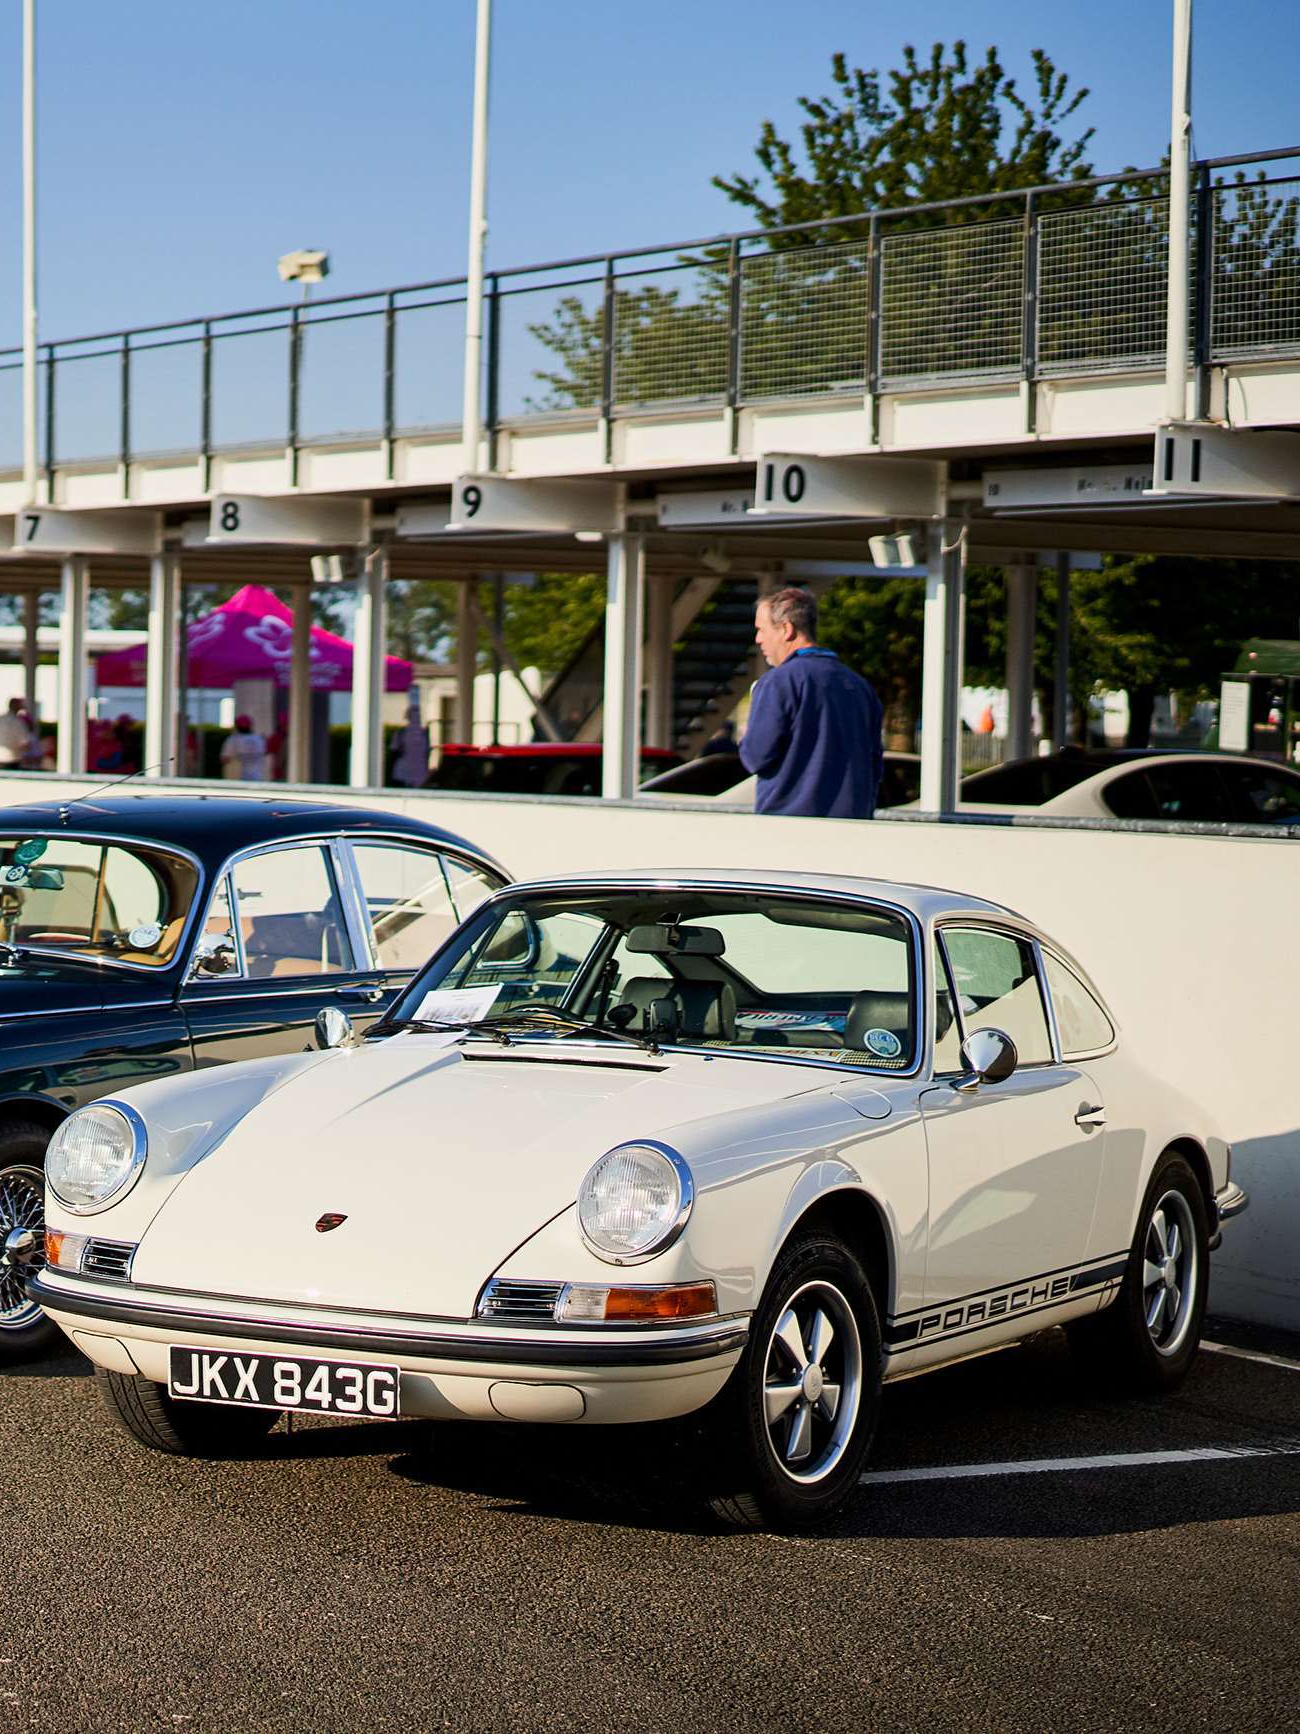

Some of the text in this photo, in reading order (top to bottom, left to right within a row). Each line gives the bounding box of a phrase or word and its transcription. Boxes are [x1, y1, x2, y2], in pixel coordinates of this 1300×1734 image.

[1164, 437, 1202, 482] 11
[463, 485, 482, 518] 9
[765, 464, 806, 503] 10
[24, 515, 41, 541] 7
[221, 502, 239, 531] 8
[918, 1276, 1071, 1338] PORSCHE
[173, 1353, 396, 1415] JKX 843G
